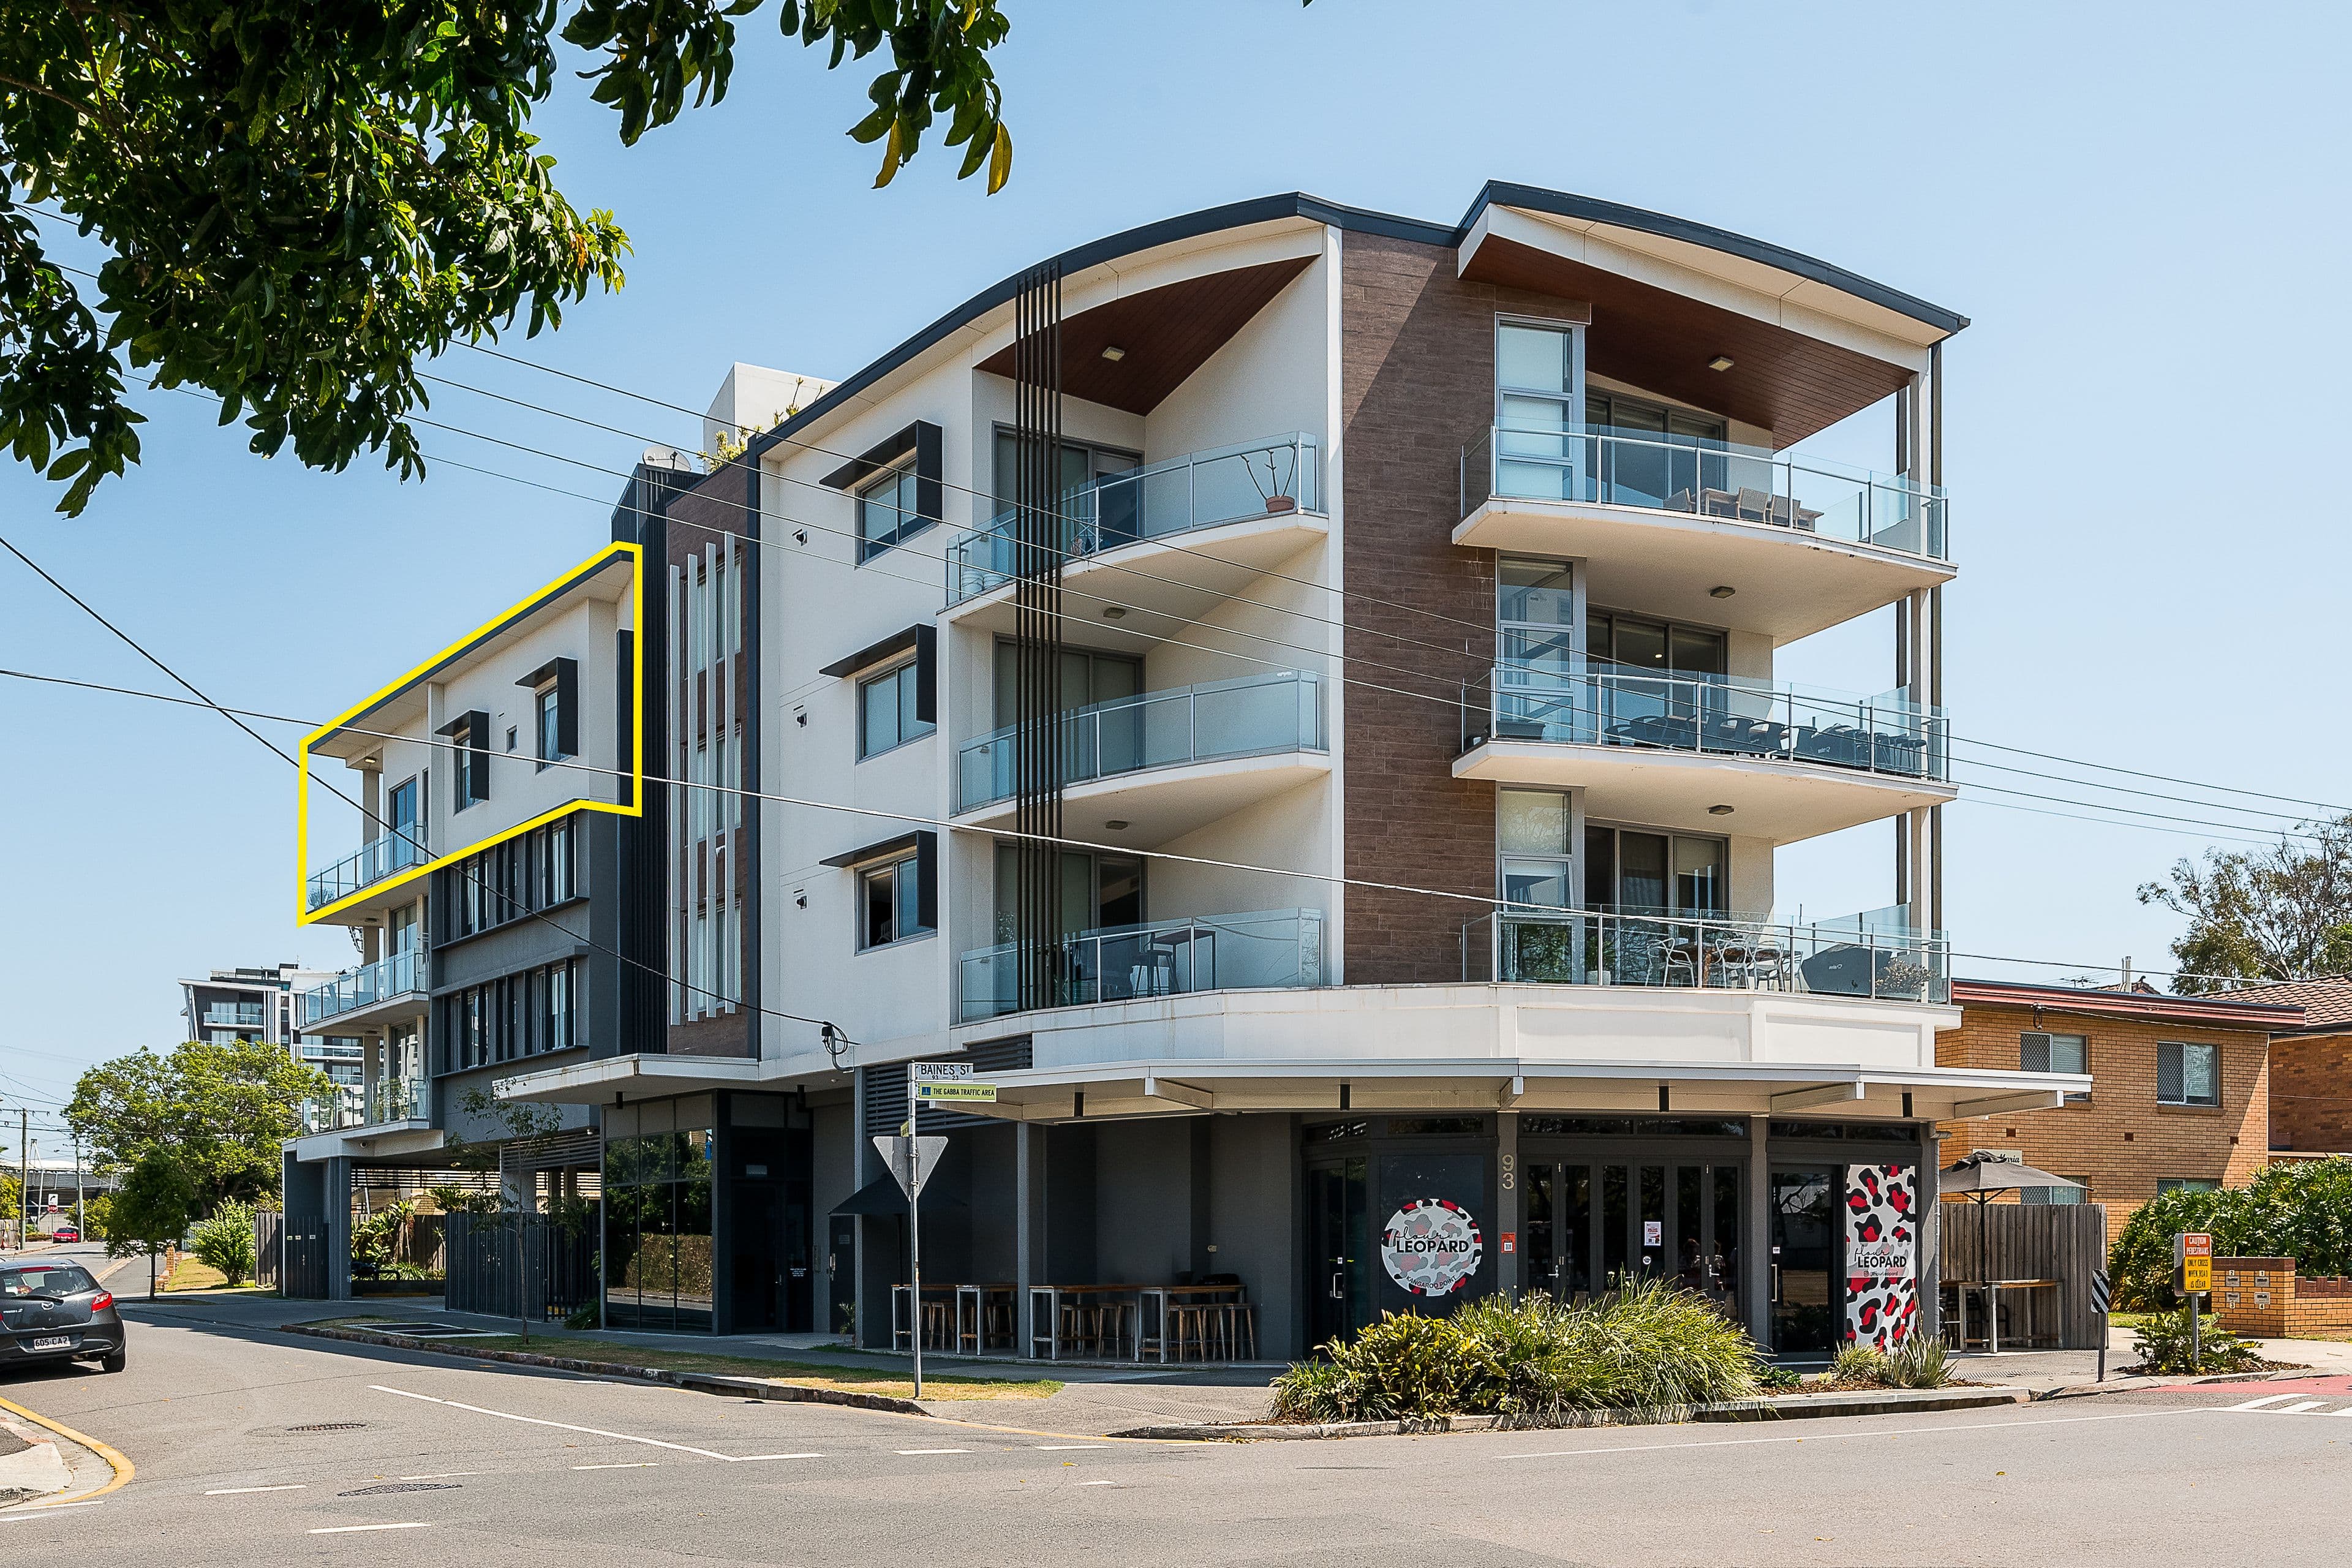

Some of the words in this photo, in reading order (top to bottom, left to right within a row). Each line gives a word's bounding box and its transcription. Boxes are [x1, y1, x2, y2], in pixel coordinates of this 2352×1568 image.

[921, 1065, 955, 1075] BAINES
[960, 1065, 970, 1075] ST
[1393, 1226, 1450, 1246] flour
[2188, 1236, 2207, 1245] CAUTION
[1396, 1240, 1469, 1253] LEOPARD
[1854, 1245, 1890, 1262] flour
[1858, 1256, 1907, 1268] LEOPARD
[1406, 1276, 1438, 1288] KANGAROO
[1439, 1275, 1457, 1287] POINT
